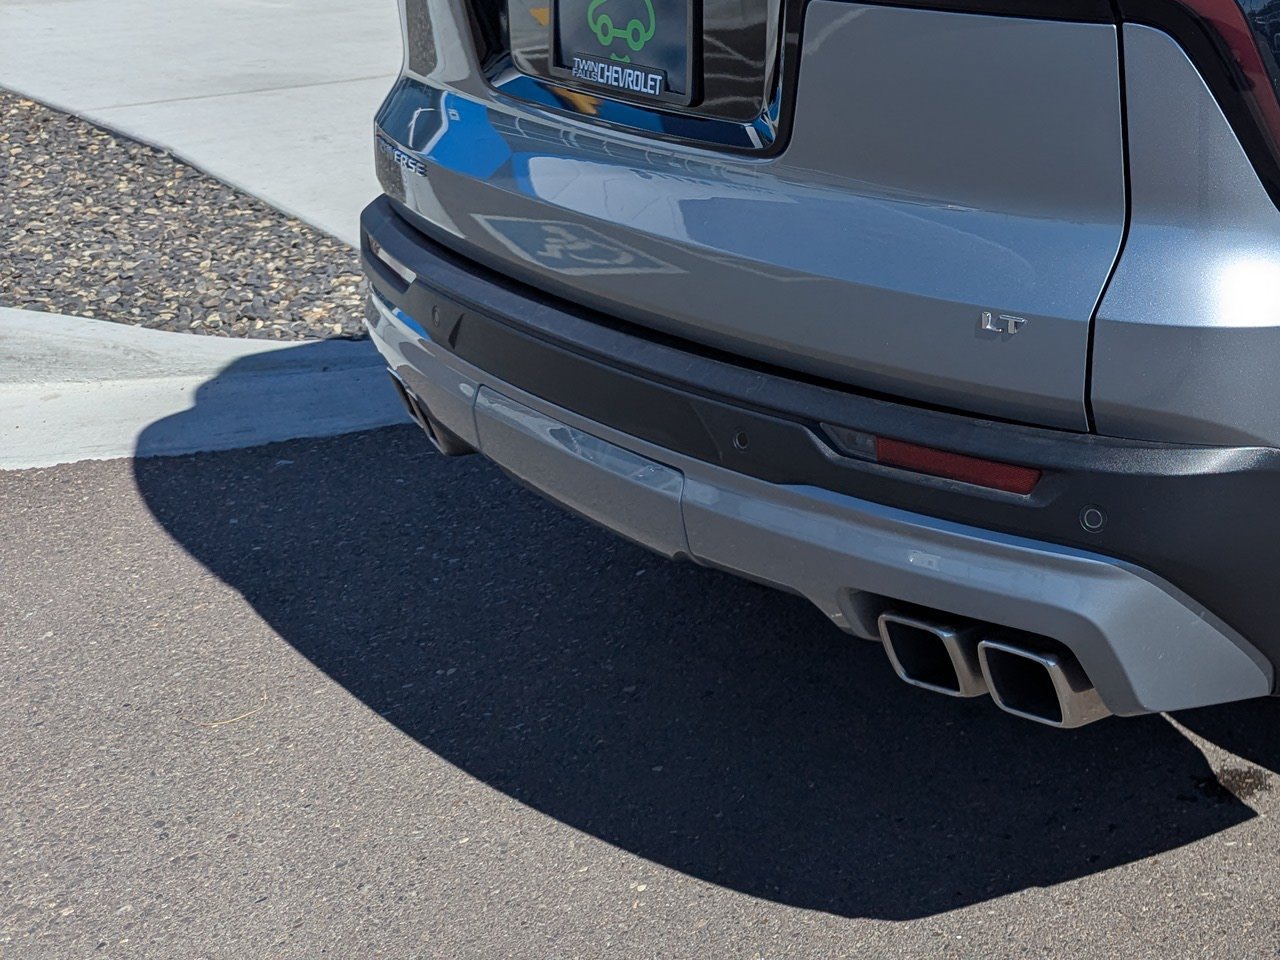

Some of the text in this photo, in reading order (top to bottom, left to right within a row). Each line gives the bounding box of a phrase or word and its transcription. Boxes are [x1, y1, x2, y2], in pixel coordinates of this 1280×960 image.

[572, 68, 598, 82] FALLS
[573, 58, 599, 73] TWIN
[598, 63, 662, 95] CHEVROLET
[981, 311, 1028, 335] LT
